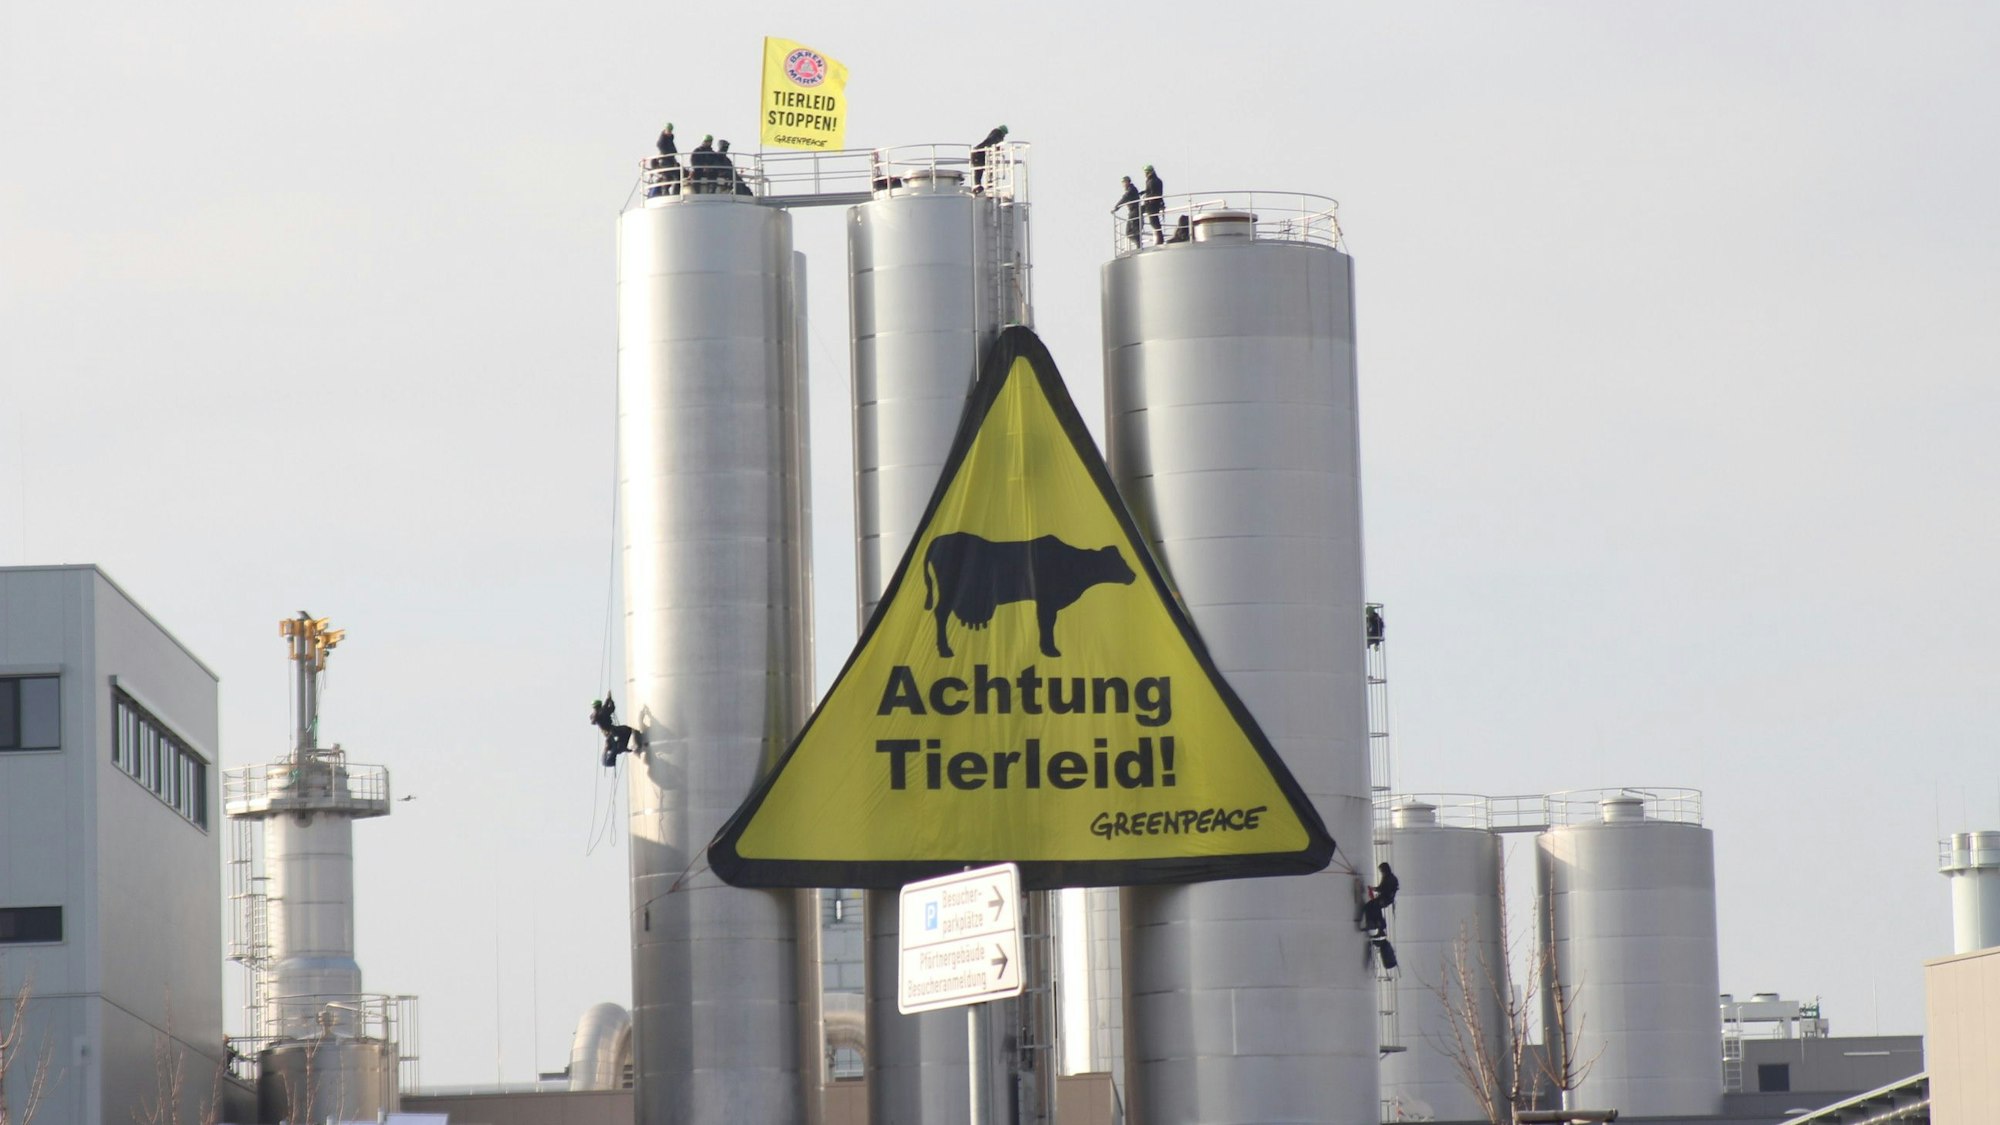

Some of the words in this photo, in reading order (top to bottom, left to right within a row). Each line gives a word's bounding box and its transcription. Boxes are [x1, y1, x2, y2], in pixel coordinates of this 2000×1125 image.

[773, 90, 836, 111] TIERLEID
[768, 110, 837, 132] STOPPEN!
[774, 134, 828, 147] GREENPEACE
[876, 664, 1173, 727] Achtung
[876, 736, 1176, 790] Tierleid!
[1090, 806, 1268, 840] GREENPEACE
[942, 886, 982, 908] Besucher-
[942, 910, 984, 938] parkplätze
[919, 942, 985, 971] Pförtnergebäude
[908, 969, 987, 998] Besucheranmeldung
